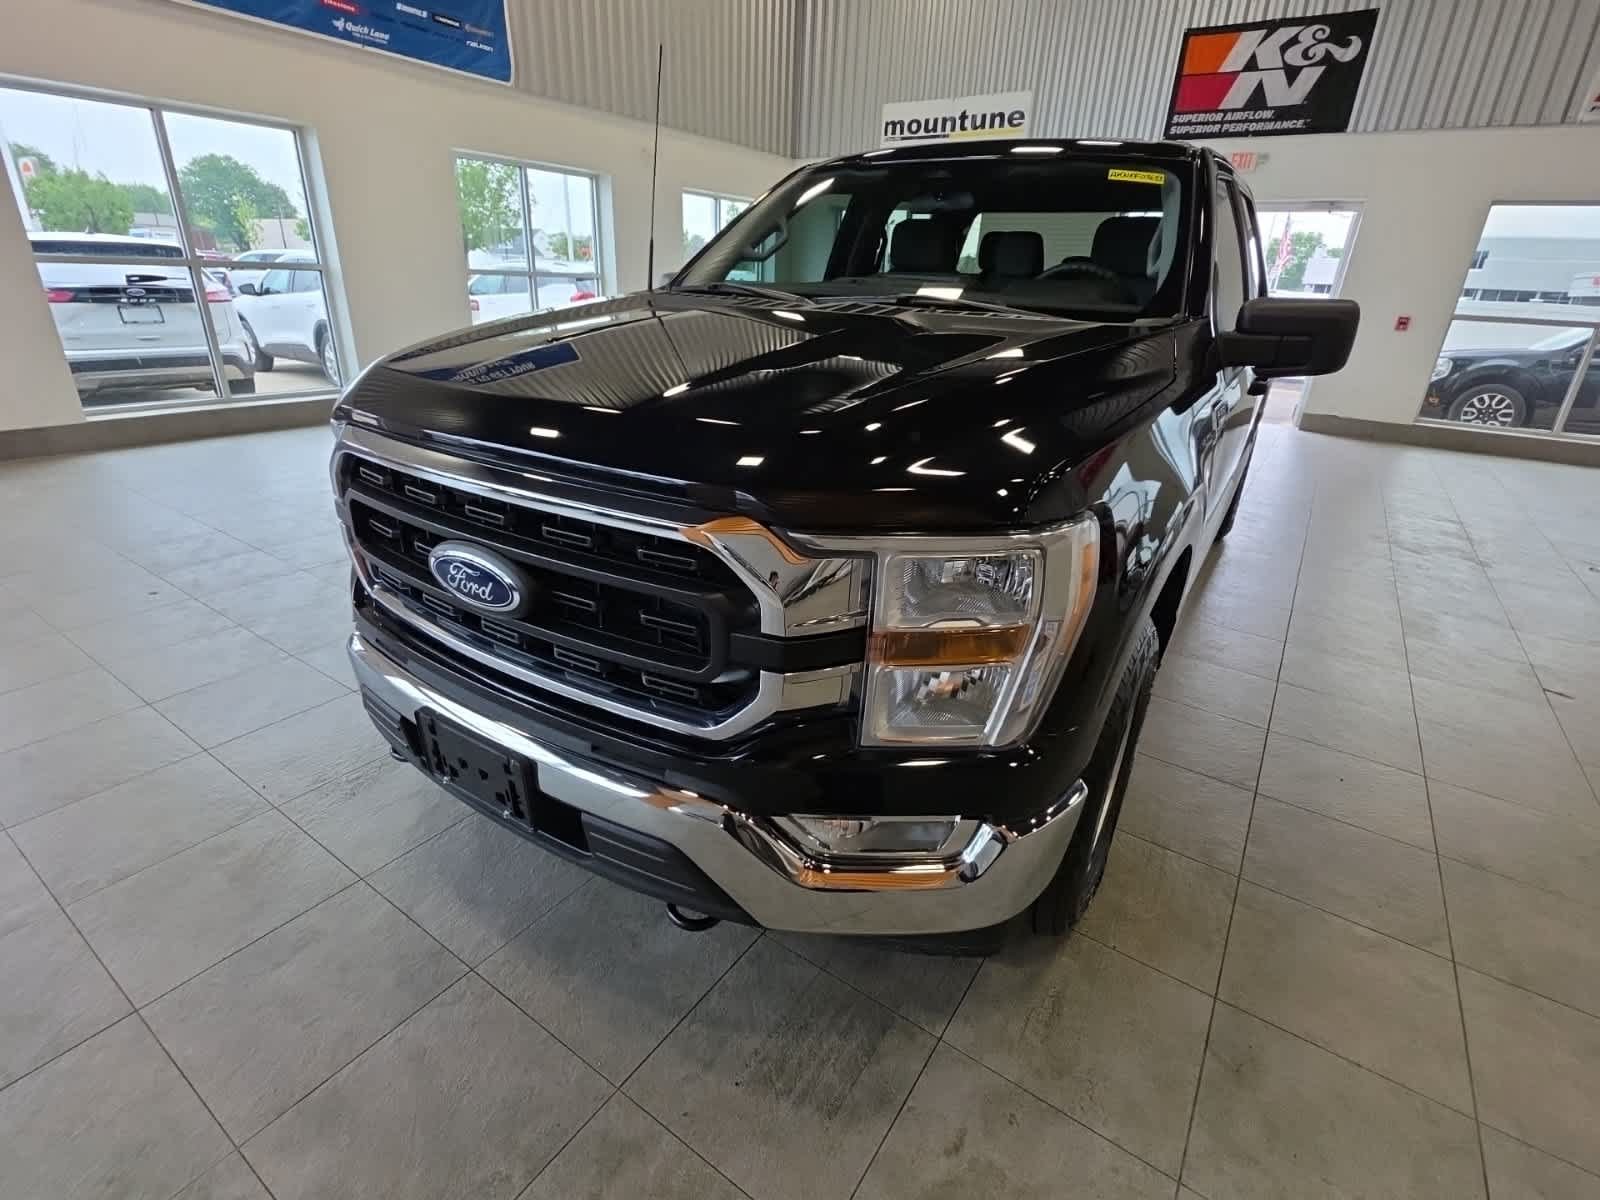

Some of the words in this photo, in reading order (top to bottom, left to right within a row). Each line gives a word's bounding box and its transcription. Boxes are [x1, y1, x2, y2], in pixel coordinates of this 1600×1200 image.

[884, 109, 1025, 136] mountune
[1171, 112, 1224, 124] SUPERIOR
[1169, 124, 1221, 135] SUPERIOR
[1231, 152, 1252, 169] EXIT
[447, 562, 494, 601] Ford
